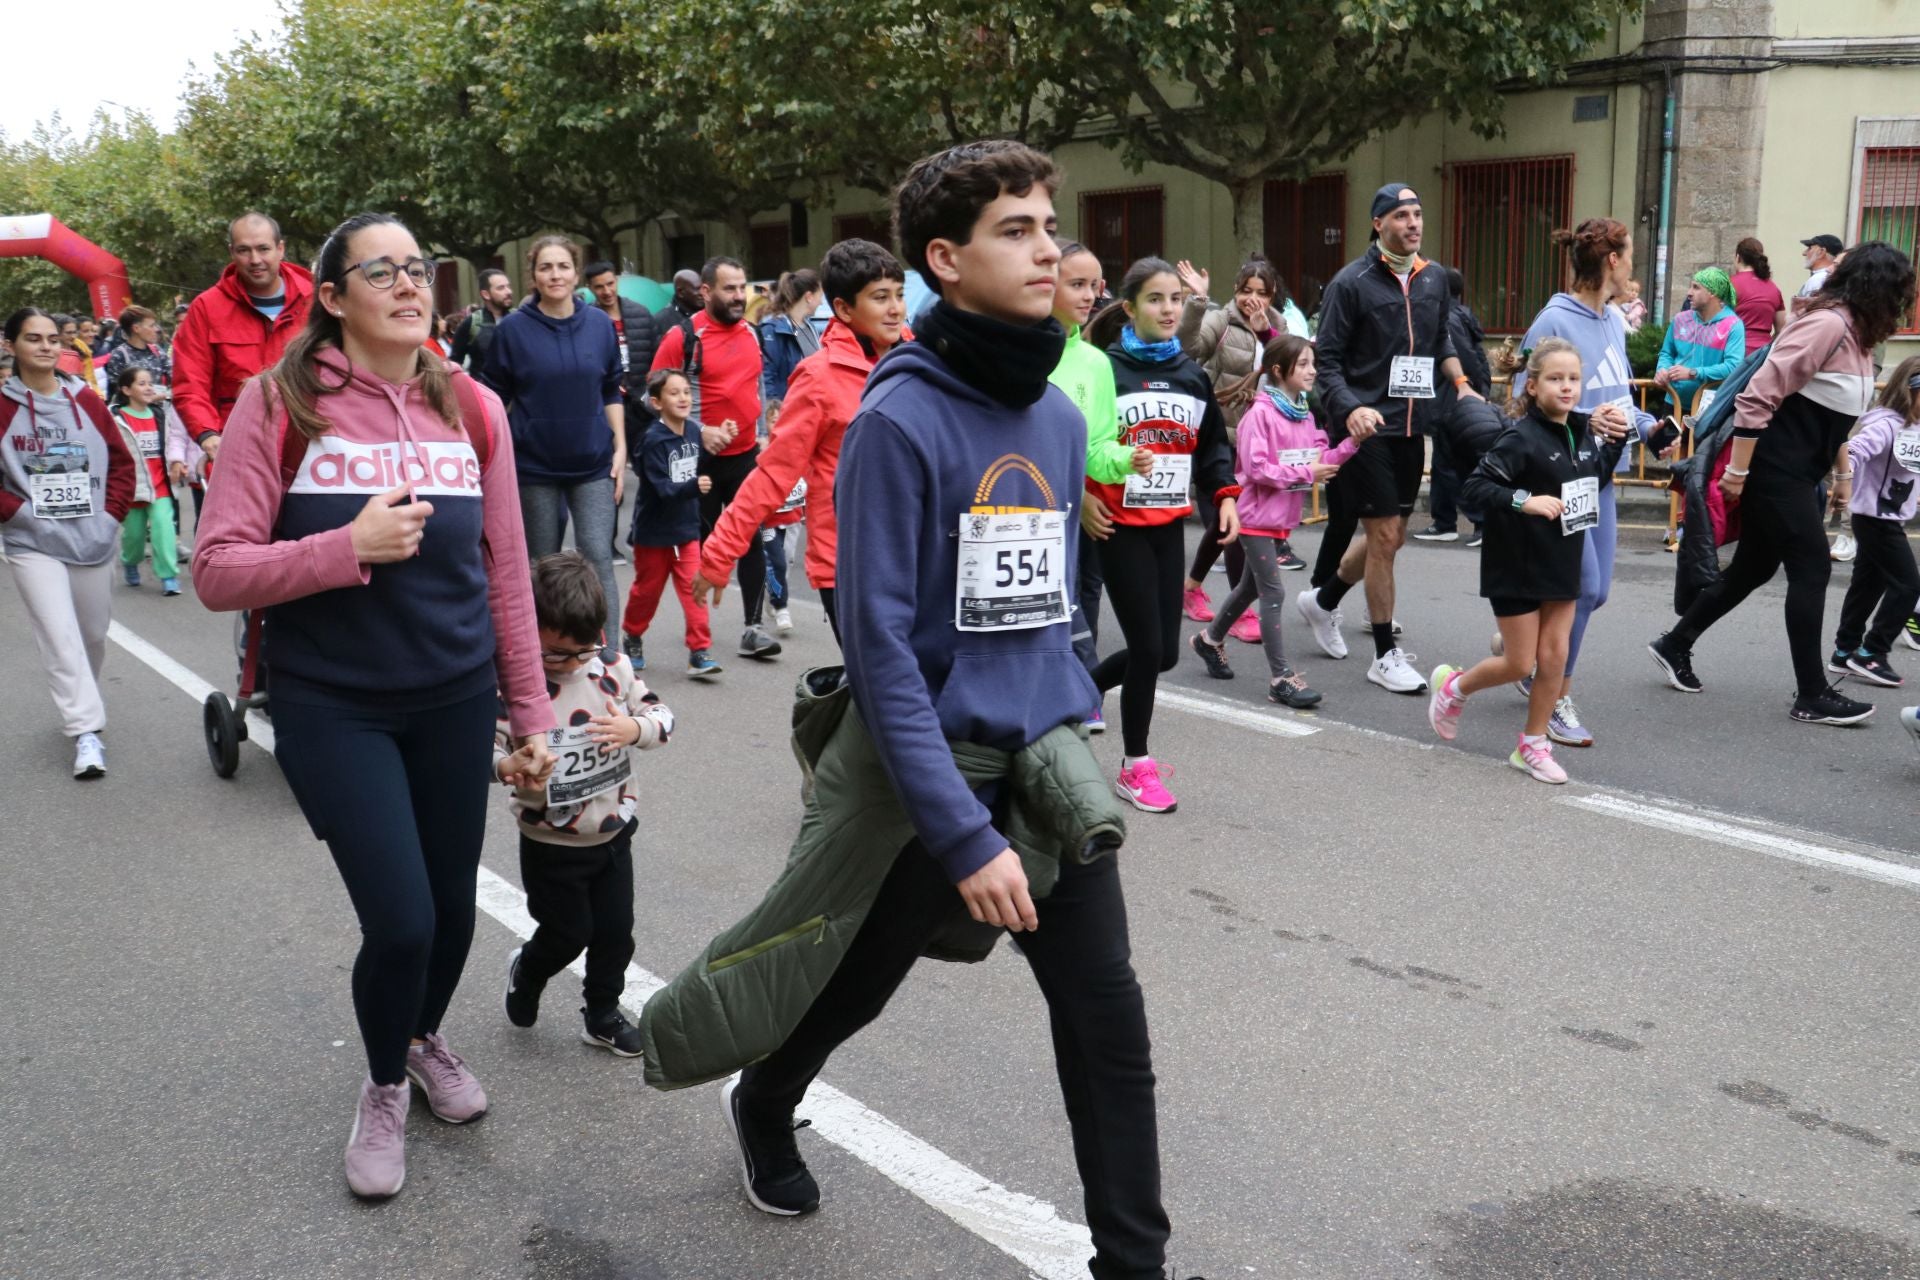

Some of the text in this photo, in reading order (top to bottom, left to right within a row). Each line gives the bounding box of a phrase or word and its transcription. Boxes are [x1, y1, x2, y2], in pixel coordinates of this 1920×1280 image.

[1401, 369, 1422, 384] 326
[1118, 400, 1197, 440] OLEGI
[12, 435, 45, 456] Way
[309, 447, 482, 490] adidas
[1142, 472, 1176, 489] 327
[42, 486, 82, 503] 2382
[995, 547, 1050, 588] 554
